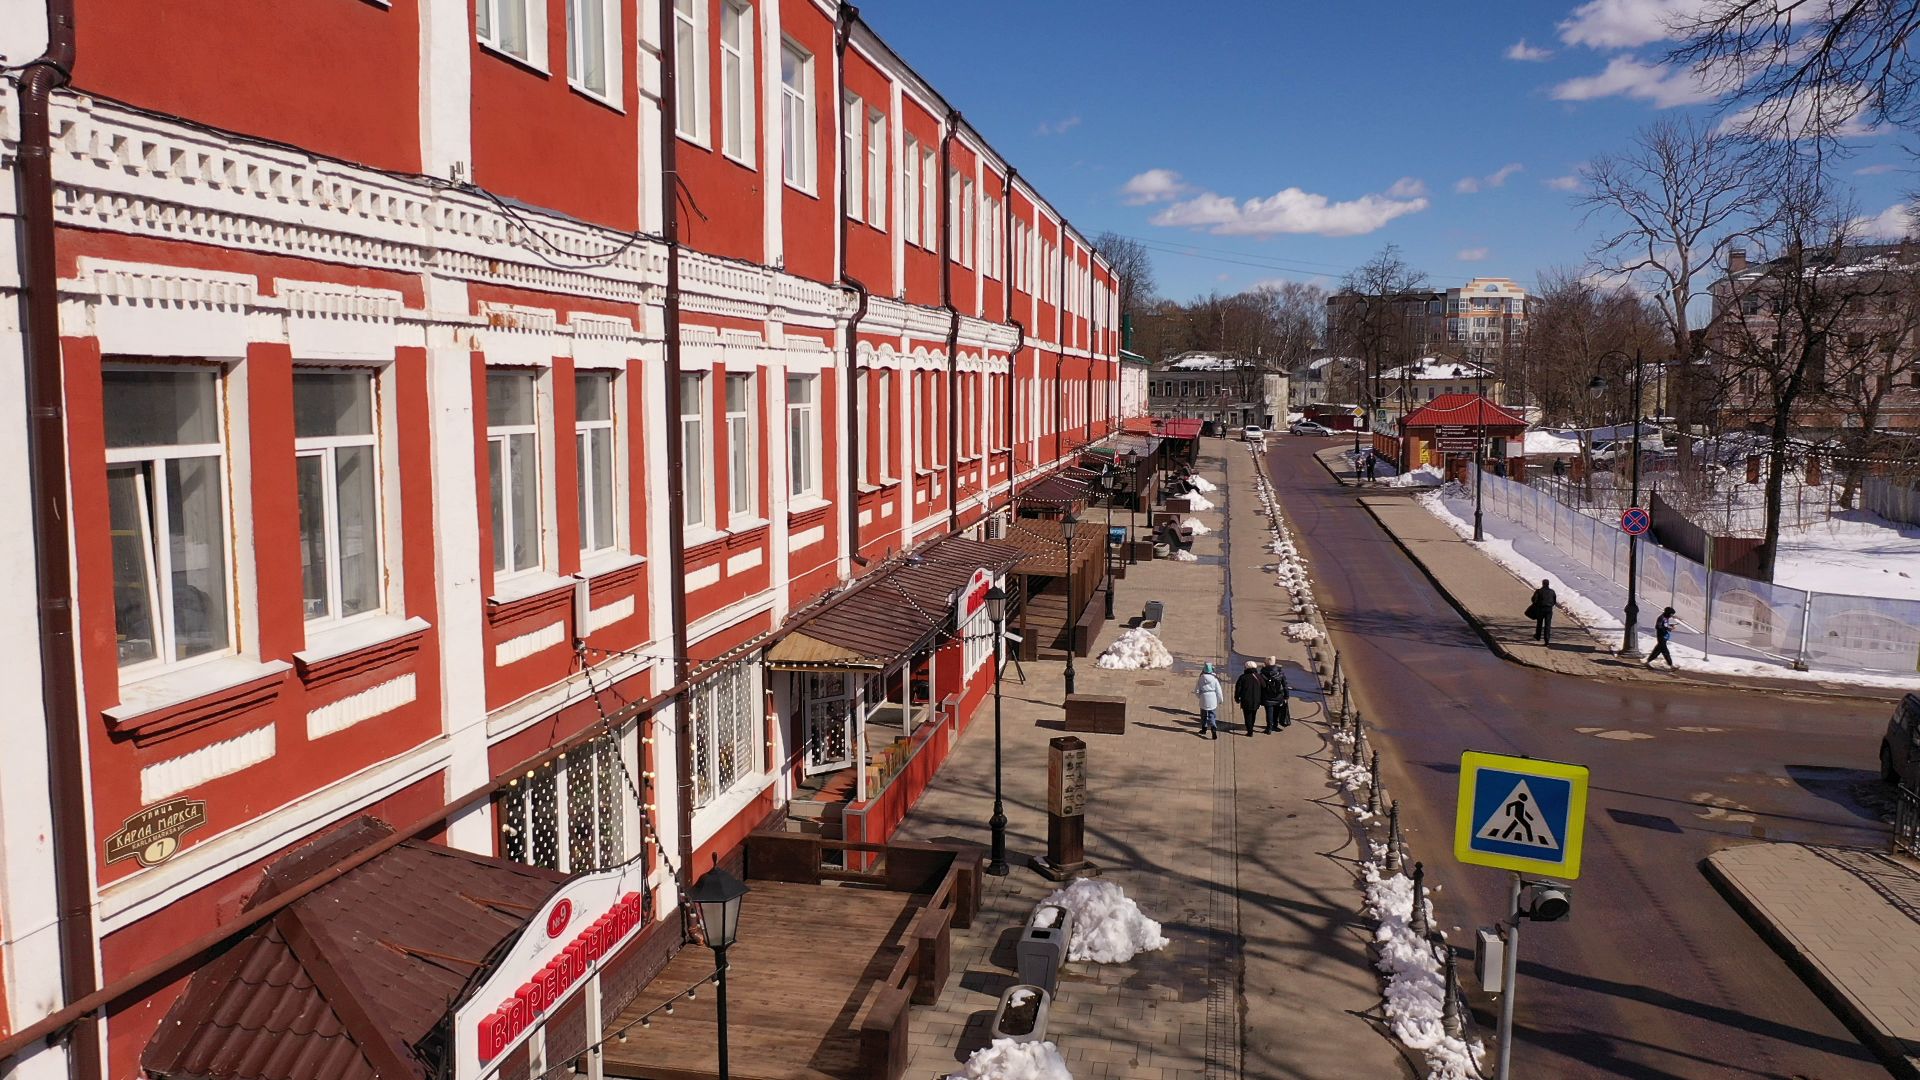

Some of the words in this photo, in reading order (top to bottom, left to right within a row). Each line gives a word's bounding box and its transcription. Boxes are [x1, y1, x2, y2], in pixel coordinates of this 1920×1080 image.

[141, 805, 173, 822] УЛИЦА
[116, 824, 152, 848] КАРЛА
[158, 805, 197, 831] МАРКСА
[132, 838, 152, 850] KARLA
[152, 828, 177, 842] MARKSA
[157, 840, 165, 857] 7
[479, 892, 641, 1061] ВАРЕНИЧНАЯ
